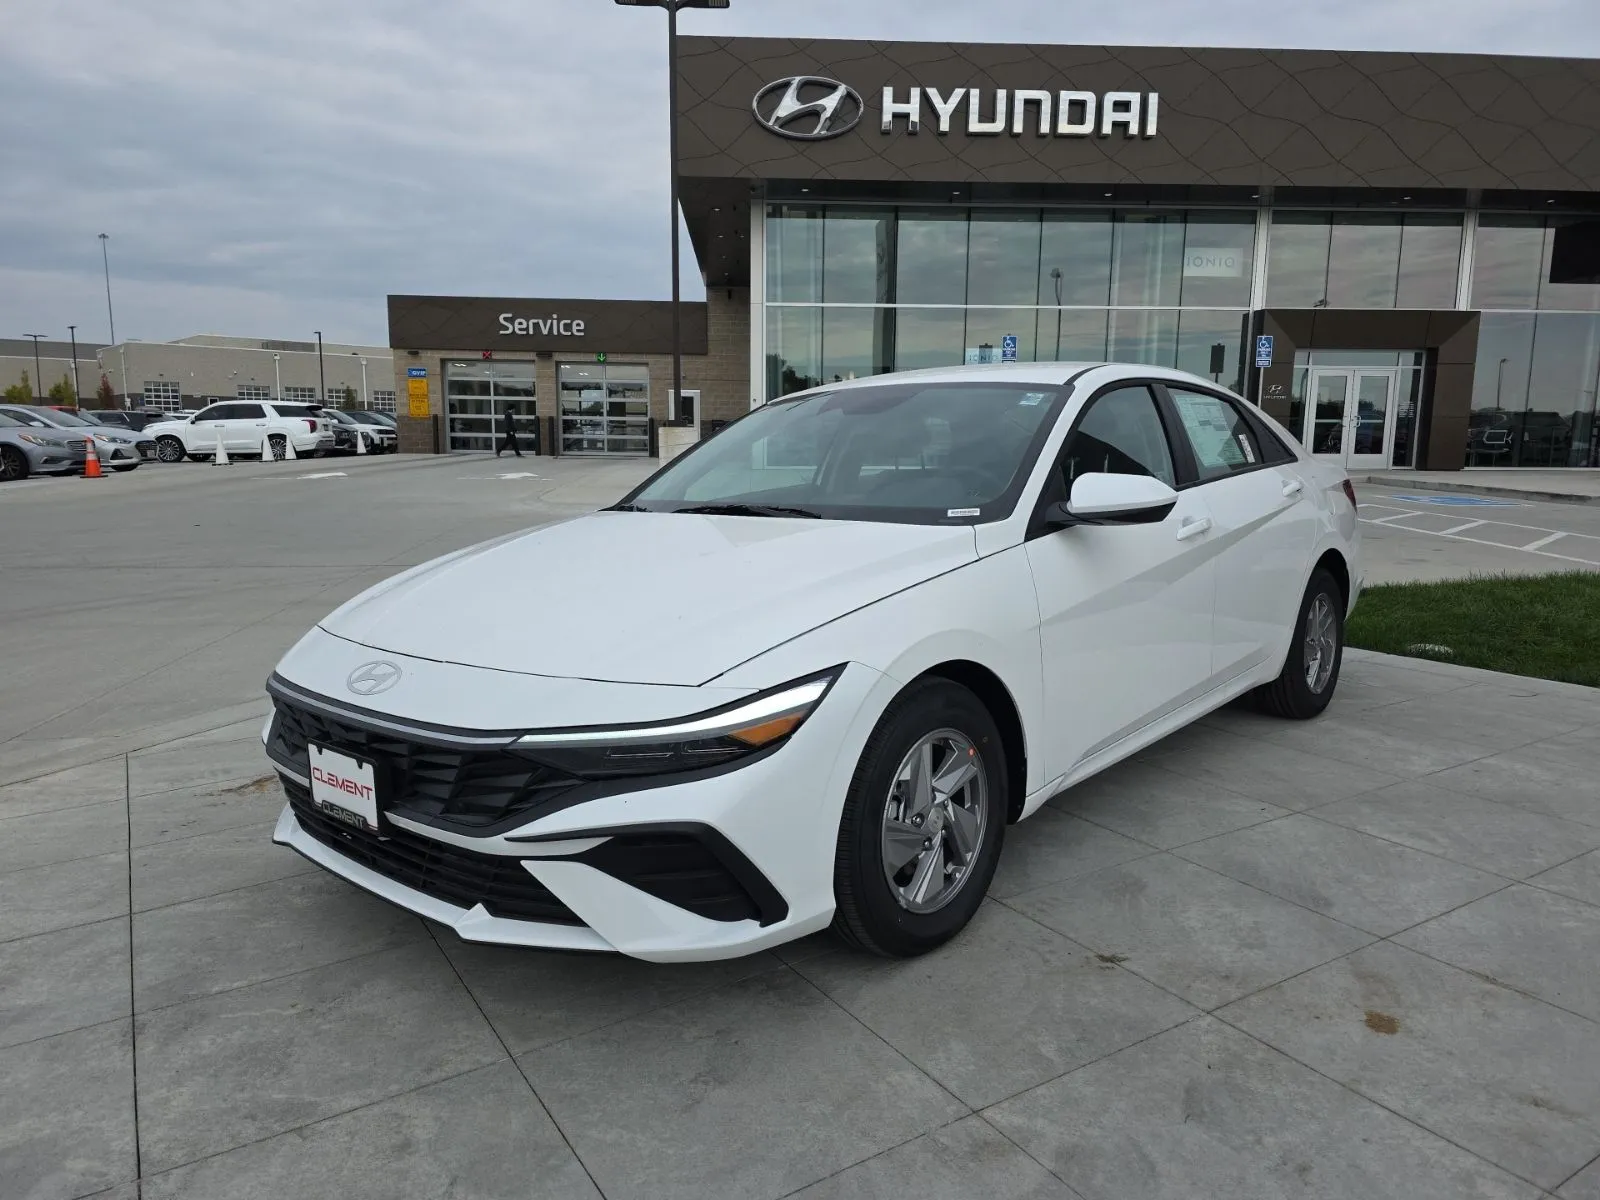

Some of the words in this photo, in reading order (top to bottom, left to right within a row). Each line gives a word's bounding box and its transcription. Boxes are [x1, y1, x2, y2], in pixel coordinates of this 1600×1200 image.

[881, 86, 1159, 137] HYUNDAI
[498, 313, 585, 336] Service
[312, 767, 373, 801] CLEMENT
[322, 801, 364, 829] CLEMENT
